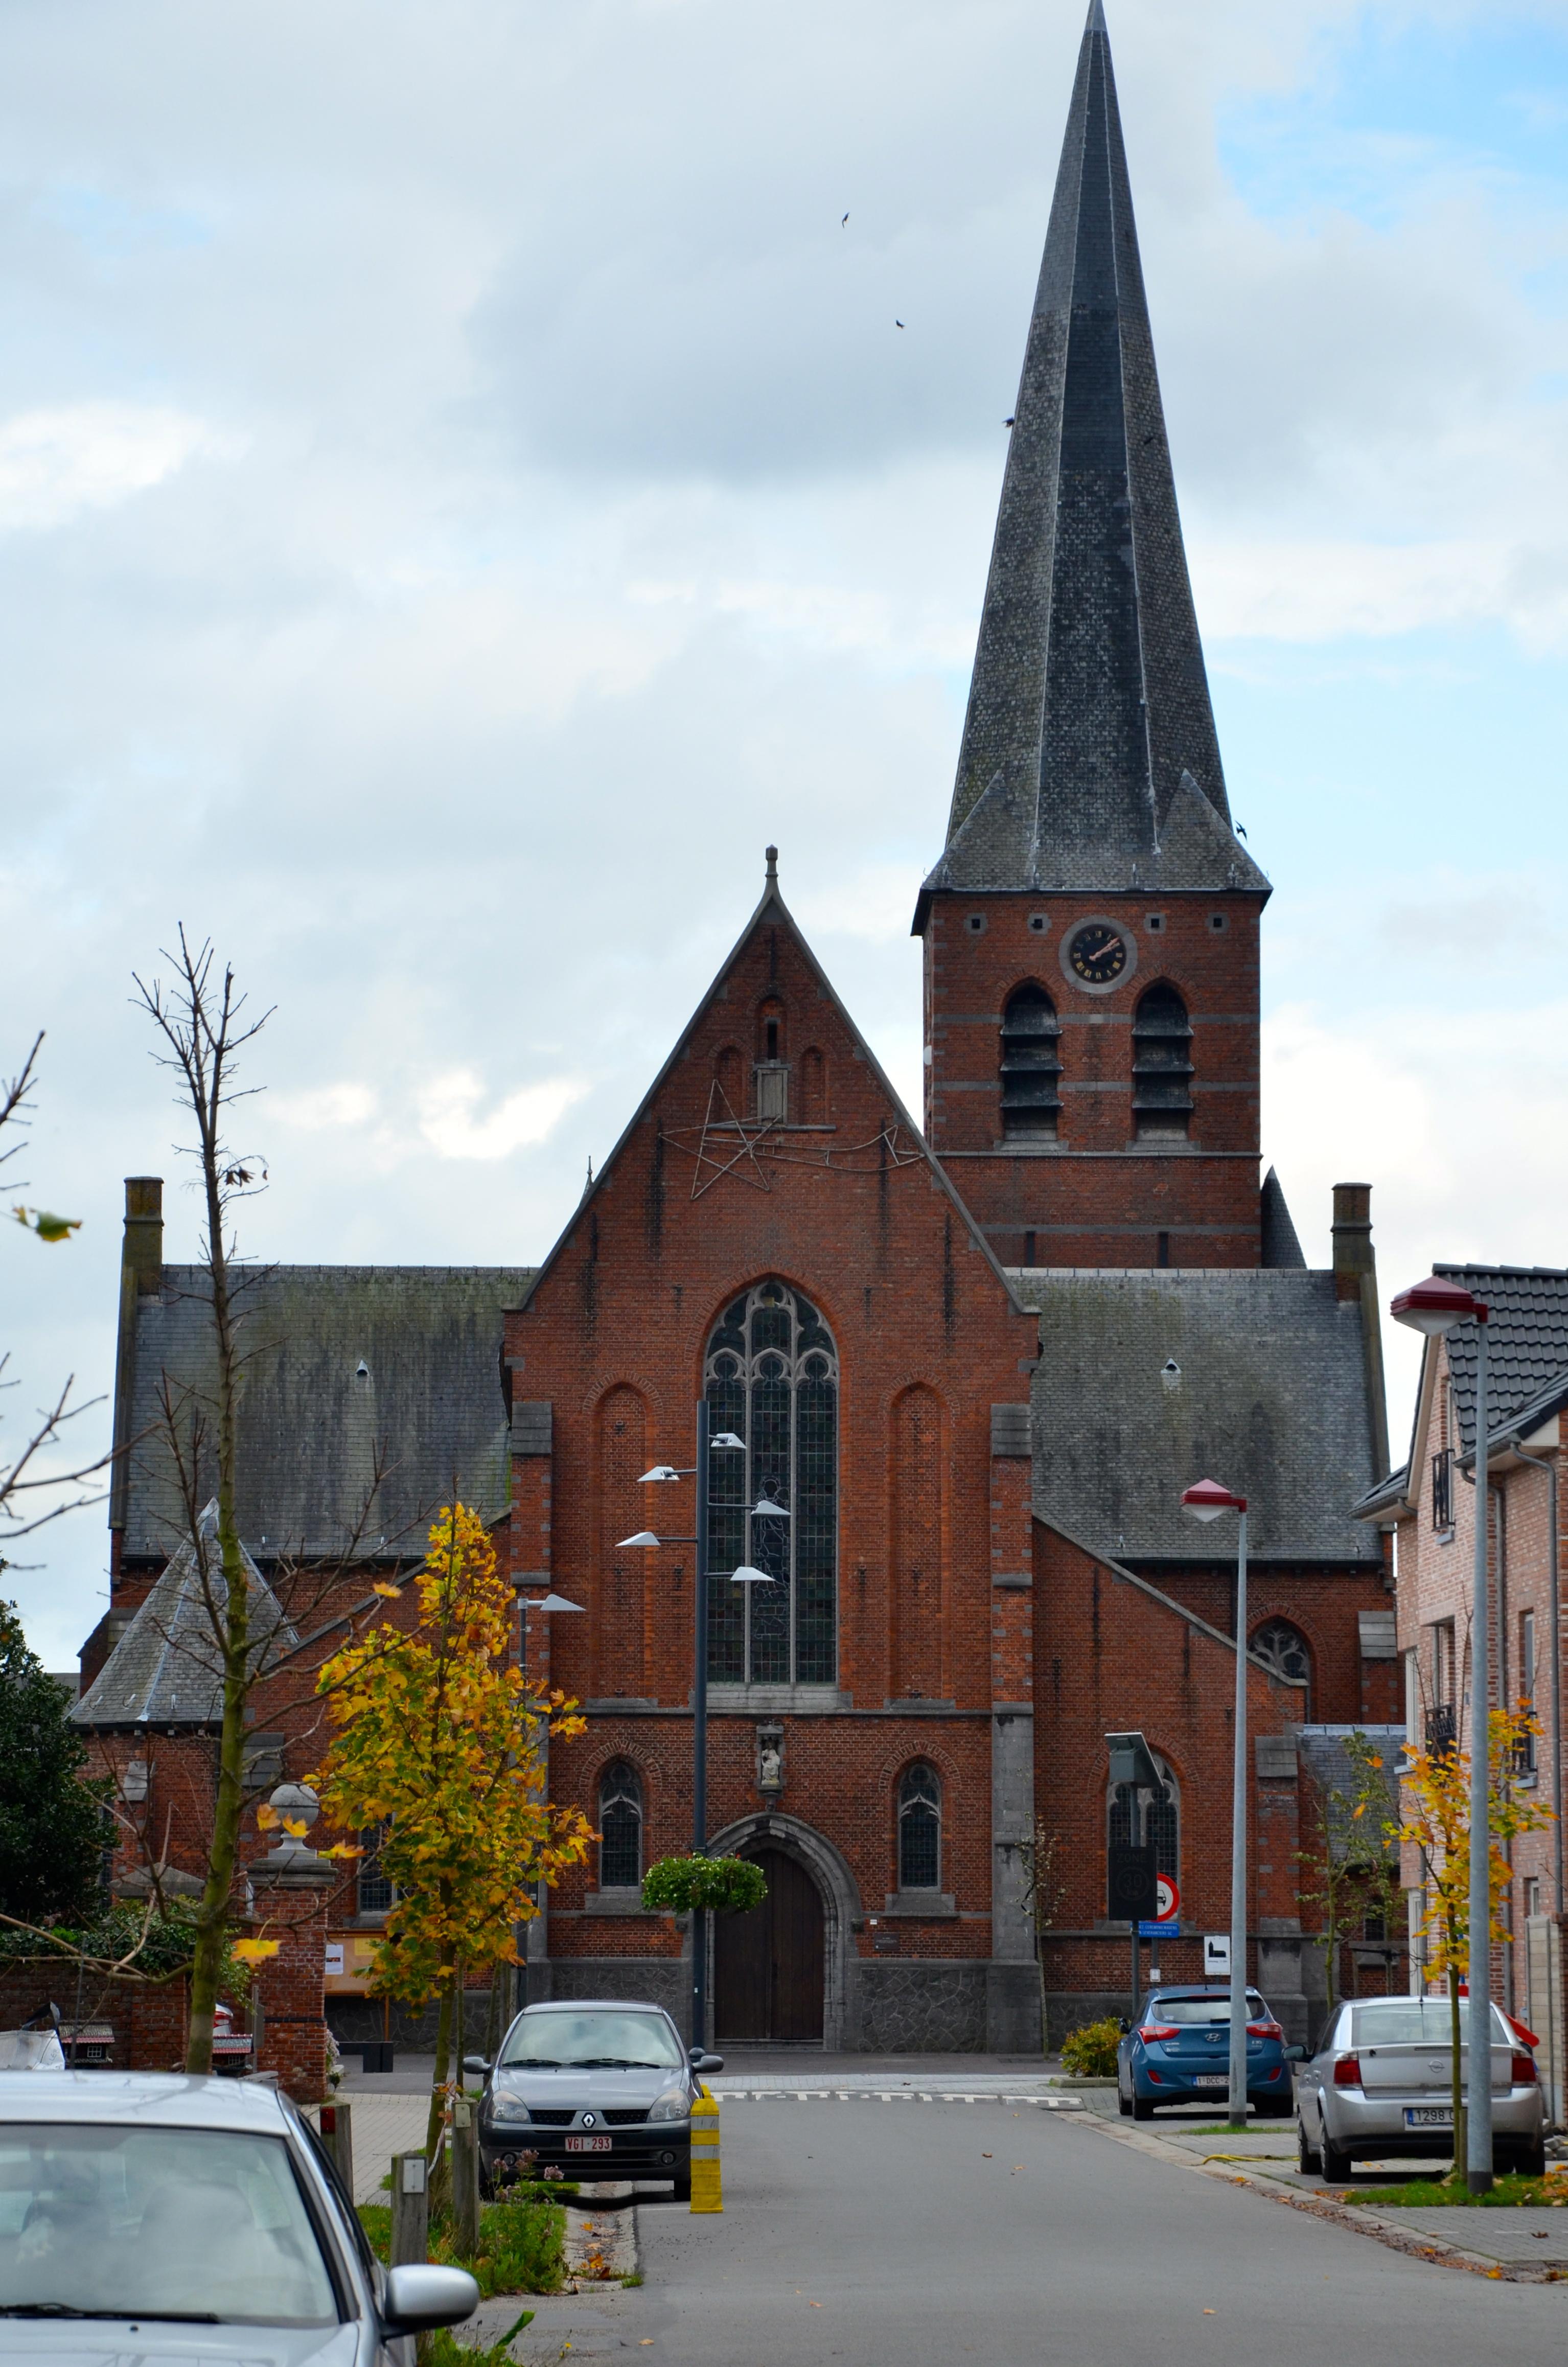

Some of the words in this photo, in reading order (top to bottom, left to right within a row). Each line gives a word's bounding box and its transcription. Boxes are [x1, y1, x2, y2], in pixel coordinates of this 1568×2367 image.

[1116, 1853, 1148, 1863] ZONE
[1124, 1874, 1142, 1888] 30
[1417, 2110, 1445, 2121] 1298
